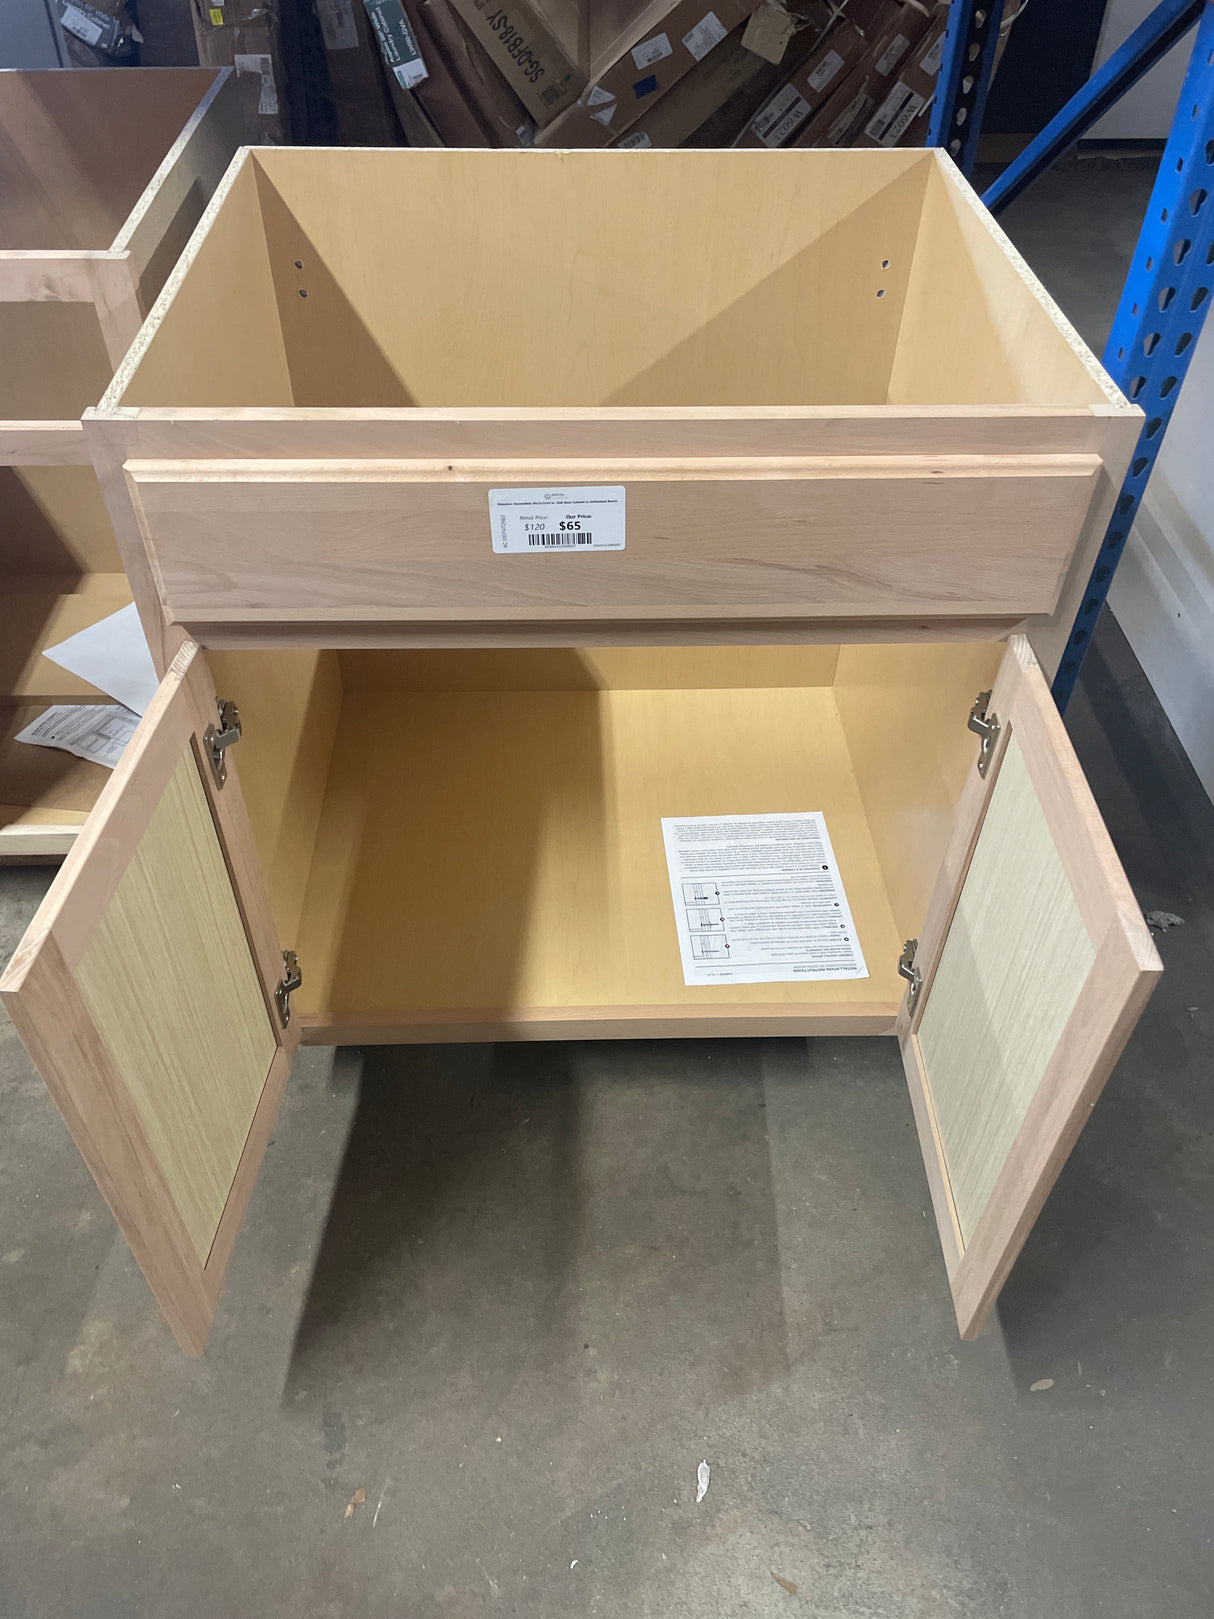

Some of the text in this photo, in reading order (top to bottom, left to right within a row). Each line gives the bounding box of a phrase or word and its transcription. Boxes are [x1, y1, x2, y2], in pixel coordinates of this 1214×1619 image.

[375, 6, 400, 61] Laundry Cabinet
[486, 9, 545, 83] SG-DFB18-SY
[524, 523, 545, 531] $120
[559, 521, 581, 532] $65
